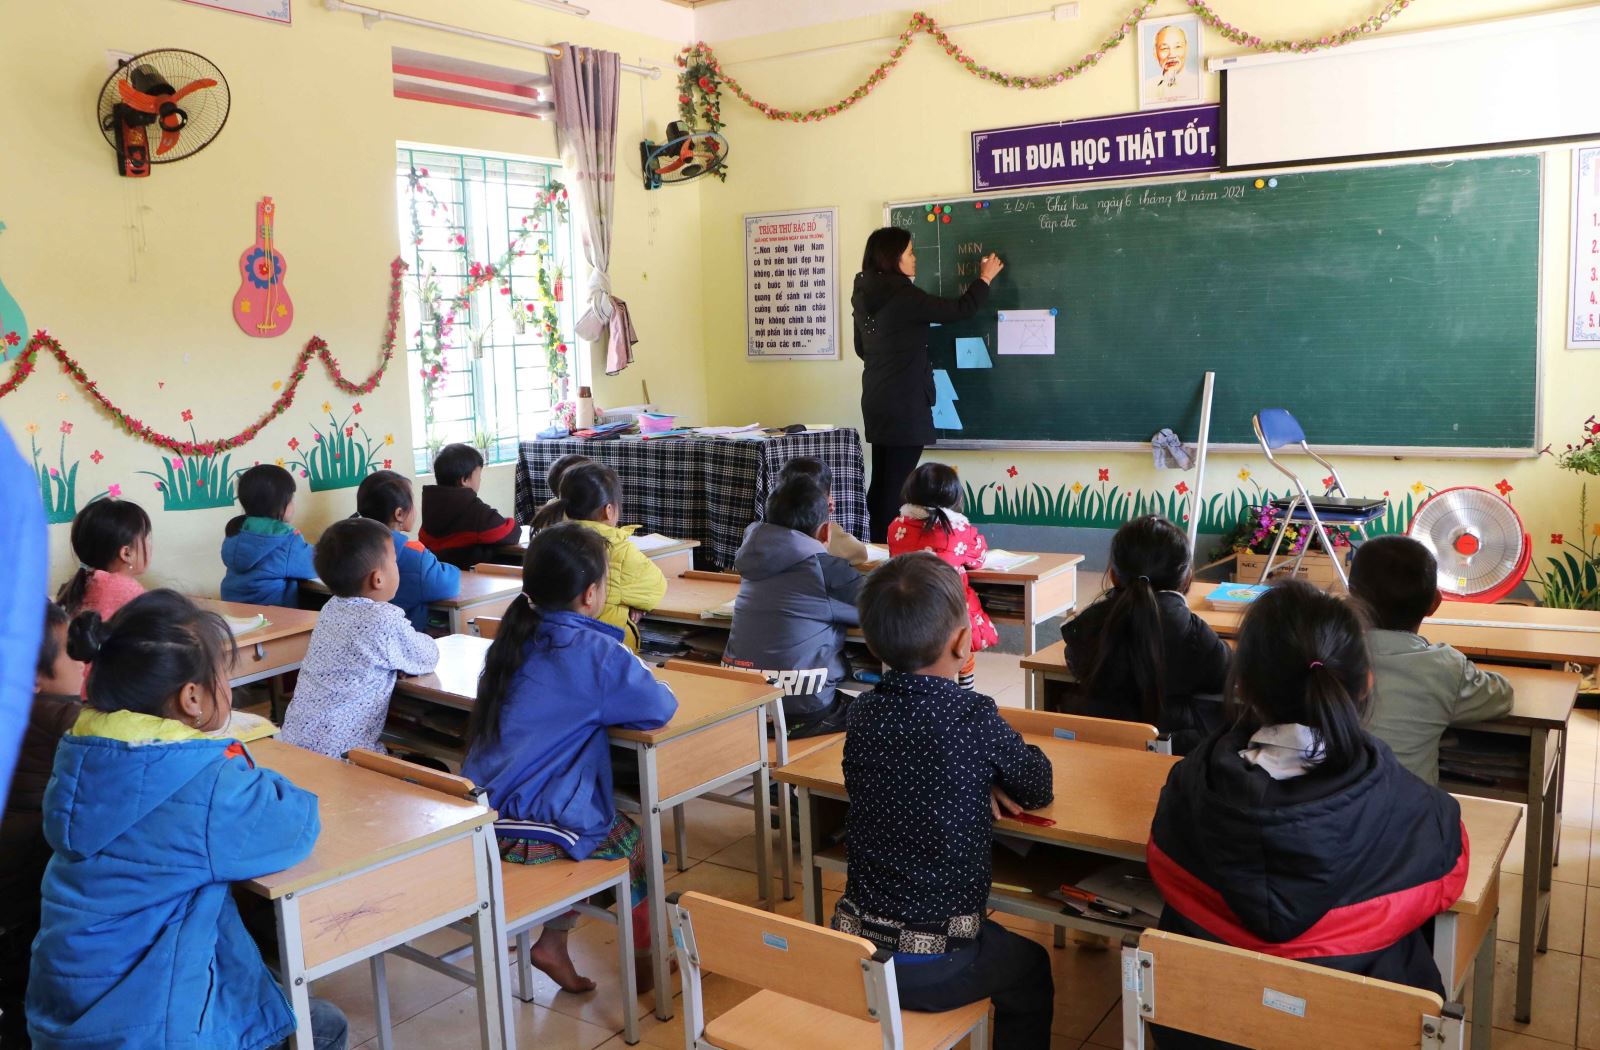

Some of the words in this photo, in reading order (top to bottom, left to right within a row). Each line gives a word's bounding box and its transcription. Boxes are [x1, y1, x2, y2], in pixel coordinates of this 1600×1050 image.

[992, 146, 1020, 174] THI
[1026, 142, 1065, 171] ĐUA
[1071, 137, 1110, 170] HỌC
[1116, 127, 1166, 166] THẬT
[1172, 118, 1216, 156] TỐT,
[794, 244, 804, 253] Việt
[801, 256, 811, 264] đẹp
[815, 255, 824, 263] hay
[799, 268, 810, 276] Việt
[812, 266, 825, 274] Nam
[814, 278, 826, 286] vinh
[786, 292, 800, 300] sánh
[804, 291, 812, 299] vai
[754, 316, 764, 326] hay
[816, 328, 826, 336] học
[766, 339, 776, 348] của
[780, 340, 790, 348] các
